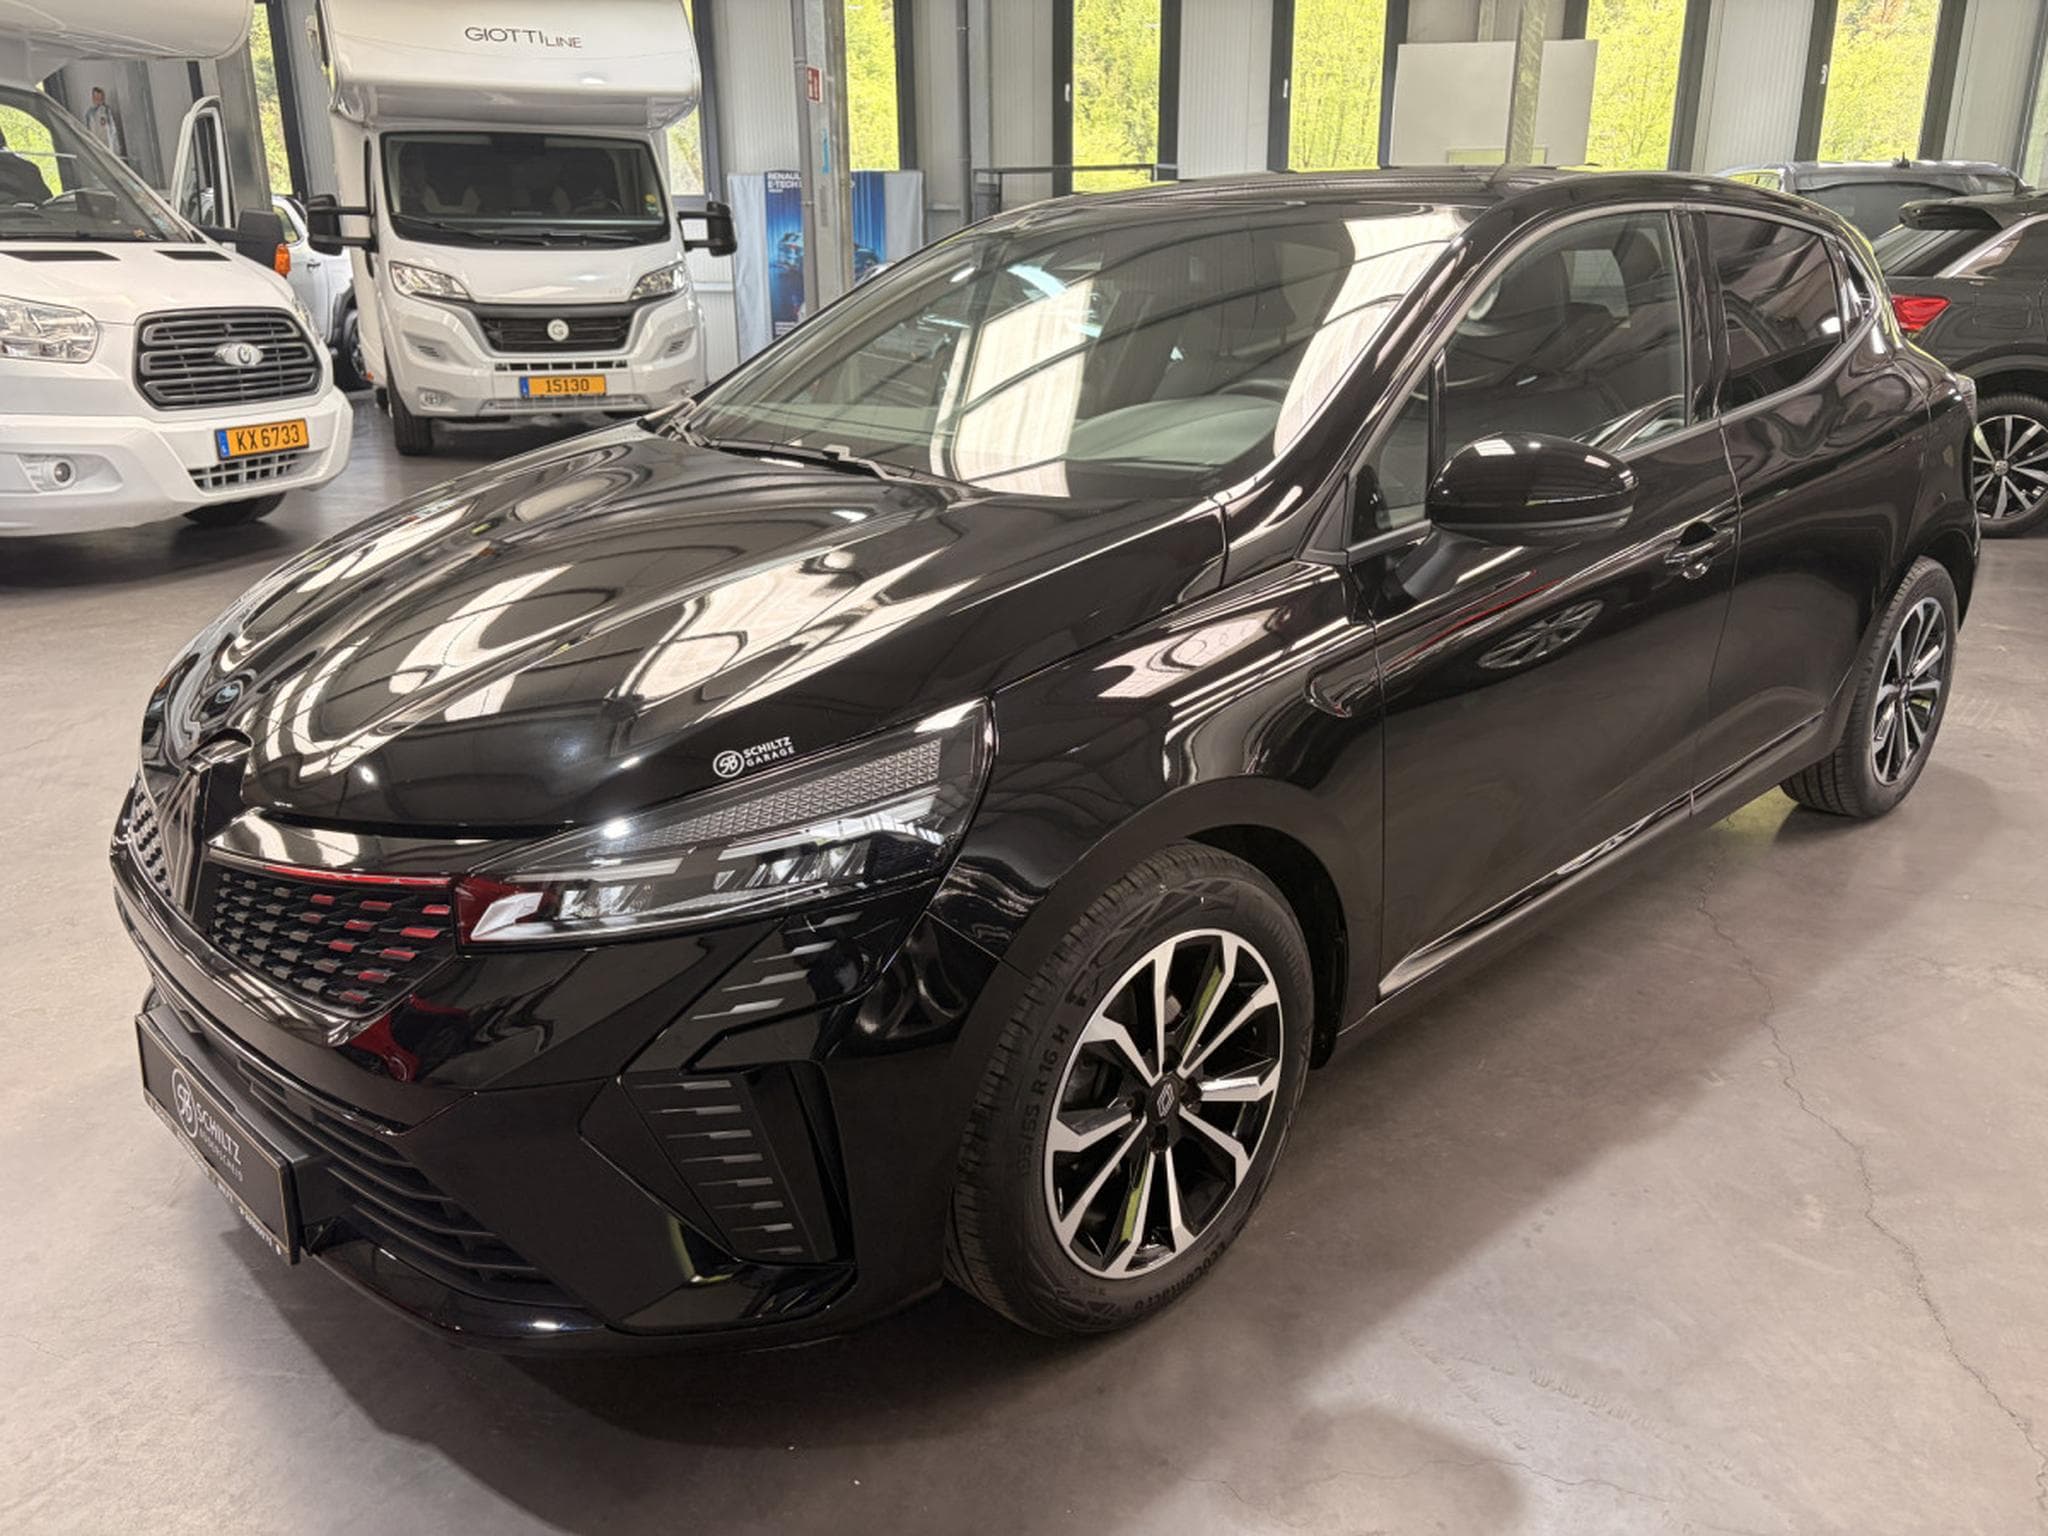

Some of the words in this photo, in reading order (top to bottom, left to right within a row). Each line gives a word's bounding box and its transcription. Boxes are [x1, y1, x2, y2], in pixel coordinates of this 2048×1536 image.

[545, 378, 590, 393] 15130
[742, 736, 793, 759] SCHILTZ
[745, 745, 796, 767] GARAGE
[196, 1102, 242, 1165] SCHILTZ
